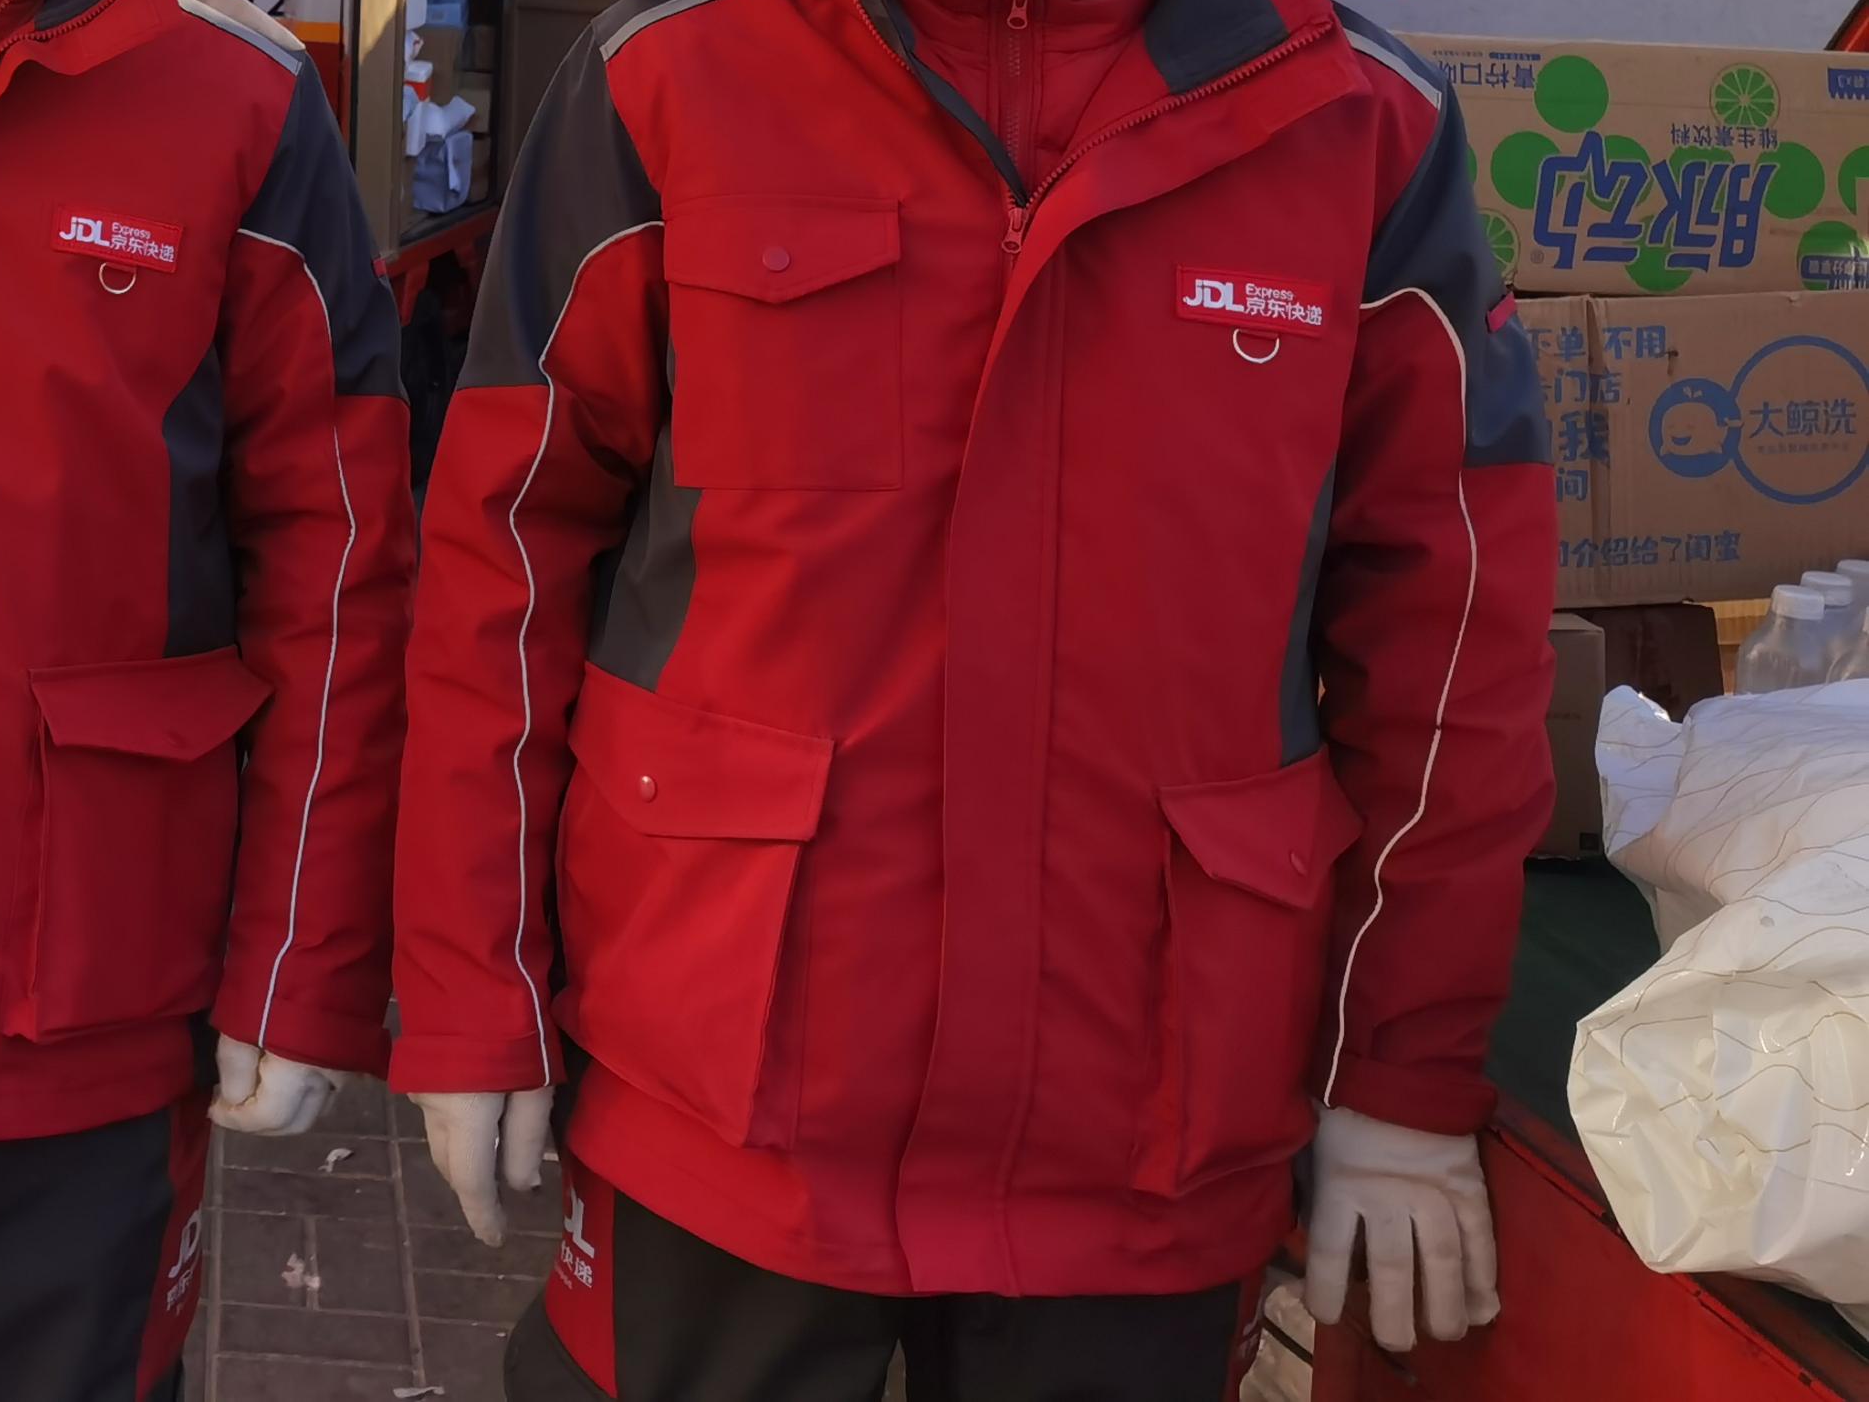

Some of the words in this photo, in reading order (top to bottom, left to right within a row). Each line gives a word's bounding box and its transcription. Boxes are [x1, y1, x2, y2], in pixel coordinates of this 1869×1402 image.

[1671, 123, 1778, 150] 维生素饮料
[1533, 130, 1778, 274] 脉动
[59, 216, 110, 247] JDL
[112, 222, 151, 238] Express
[110, 234, 175, 262] 京东快递
[1183, 279, 1244, 312] JDL
[1245, 283, 1294, 300] Express
[1245, 297, 1323, 325] 京东快递
[1749, 398, 1858, 438] 大鲸洗
